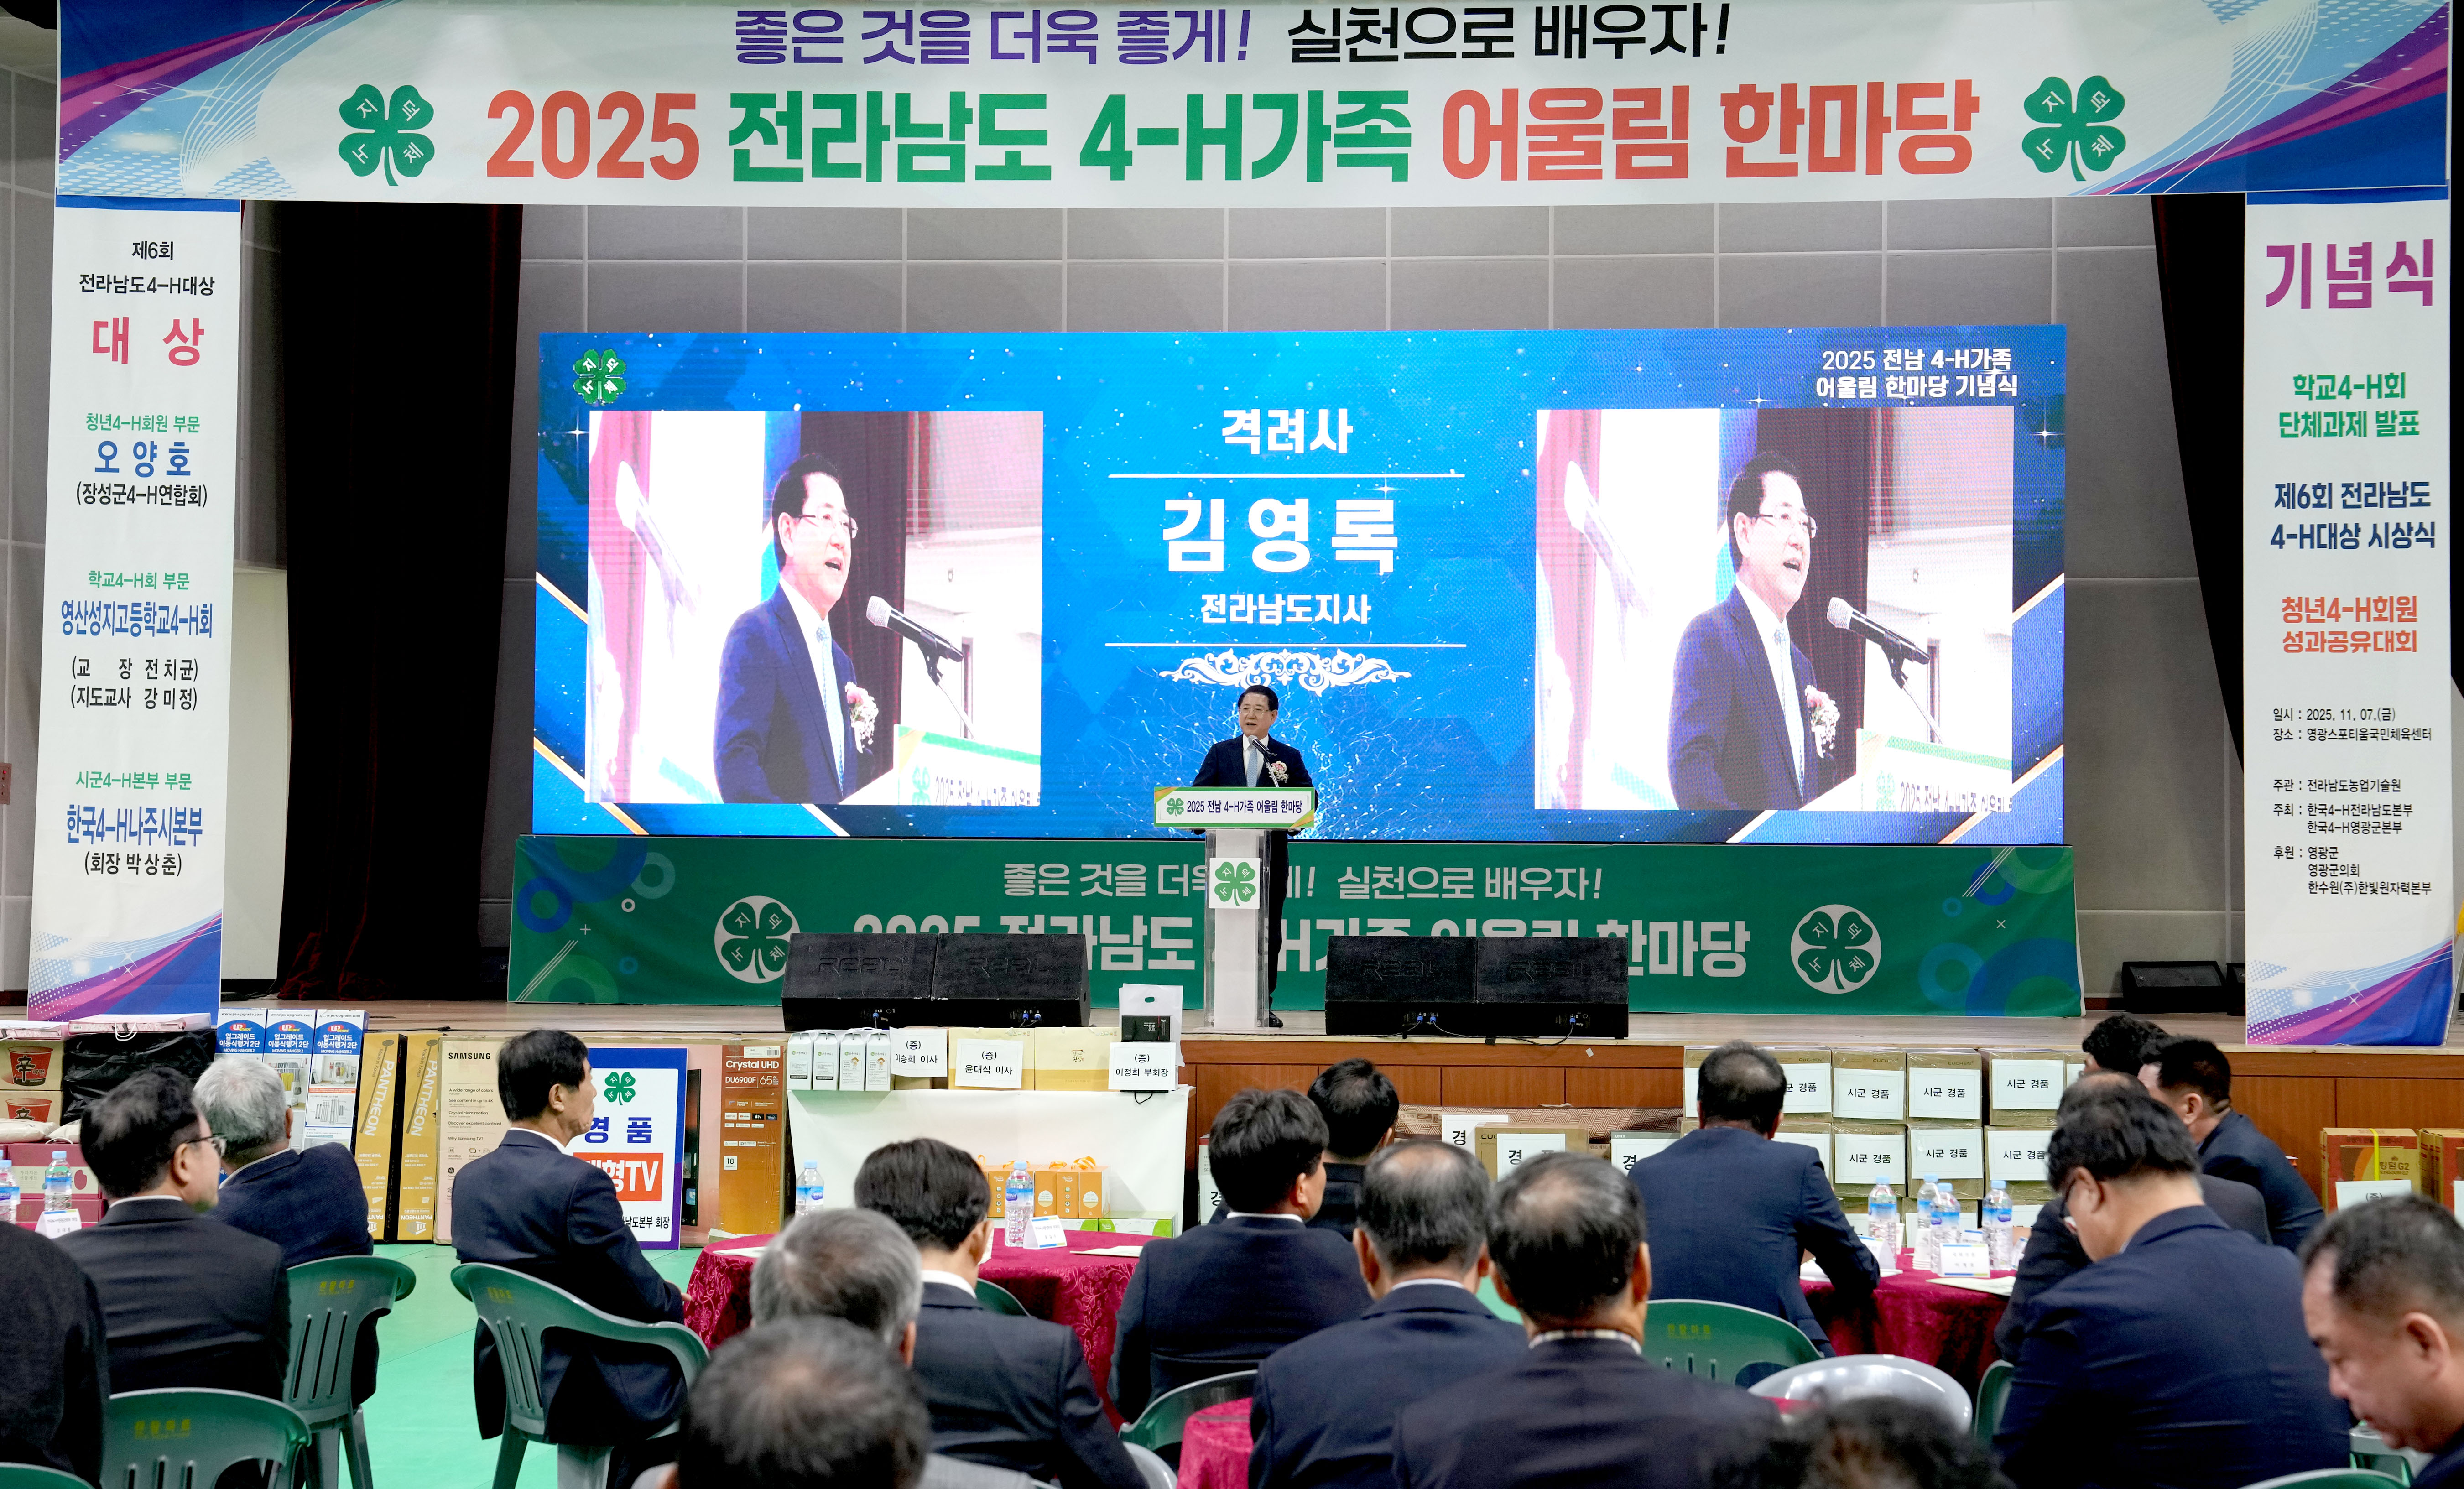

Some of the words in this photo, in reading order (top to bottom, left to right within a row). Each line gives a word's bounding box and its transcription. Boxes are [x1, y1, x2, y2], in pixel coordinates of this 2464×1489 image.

[736, 10, 844, 64] 좋은
[861, 10, 970, 64] 것을
[991, 10, 1098, 64] 더욱
[1118, 9, 1250, 64] 좋게!
[1288, 7, 1514, 63] 실천으로
[1534, 2, 1731, 60] 배우자!
[356, 98, 378, 118] 지
[487, 90, 699, 180] 2025
[729, 91, 1051, 182] 전라남도
[1080, 90, 1412, 182] 4-H가족
[1443, 85, 1689, 181] 어울림
[1720, 79, 1980, 178] 한마당
[352, 144, 368, 164] 노
[403, 142, 424, 163] 체
[132, 241, 173, 260] 제6회
[2266, 239, 2433, 309] 기념식
[79, 274, 214, 296] 전라남도4-H대상
[1823, 351, 1875, 370] 2025
[1883, 349, 1925, 370] 전남
[1931, 348, 2011, 373] 4-H가족
[1817, 376, 1876, 398] 어울림
[1885, 375, 1949, 399] 한마당
[1956, 371, 2017, 397] 기념식
[2293, 372, 2406, 401] 학교4-H회
[86, 413, 167, 432] 청년4-H회원
[173, 416, 200, 433] 부문
[1222, 409, 1353, 454] 격려사
[2280, 411, 2367, 438] 단체과제
[2376, 410, 2420, 437] 발표
[77, 481, 207, 508] (장성군4-H연합회)
[2275, 483, 2332, 509] 제6회
[2341, 481, 2431, 509] 전라남도
[2271, 523, 2361, 549] 4-H대상
[2369, 522, 2435, 549] 시상식
[89, 571, 157, 589] 학교4-H회
[163, 573, 189, 590] 부문
[62, 600, 212, 638] 영산성지고등학교4-H회
[1201, 594, 1371, 626] 전라남도지사
[2282, 596, 2417, 623] 청년4-H회원
[2283, 630, 2417, 653] 성과공유대회
[73, 656, 90, 679] (교
[119, 658, 132, 679] 장
[71, 685, 131, 708] (지도교사
[2274, 708, 2292, 721] 일시
[2307, 709, 2334, 721] 2025.
[2341, 709, 2355, 721] 11.
[2360, 708, 2395, 721] 07.(금)
[2273, 728, 2293, 741] 장소
[2308, 728, 2431, 741] 영광스포티움국민체육센터
[76, 771, 159, 790] 시군4-H본부
[165, 773, 192, 790] 부문
[2273, 779, 2293, 792] 주관
[2308, 779, 2400, 792] 전라남도농업기술원
[1187, 801, 1204, 812] 2025
[1208, 800, 1221, 813] 전남
[1224, 800, 1254, 813] 4-H가족
[1257, 800, 1277, 813] 어울림
[1281, 800, 1302, 813] 한마당
[2273, 804, 2293, 816] 주최
[2308, 803, 2412, 817] 한국4-H전라남도본부
[67, 805, 203, 847] 한국4-H나주시본부
[2308, 821, 2402, 834] 한국4-H영광군본부
[2274, 846, 2293, 859] 후원
[2308, 847, 2339, 859] 영광군
[85, 851, 120, 875] (회장
[2308, 864, 2359, 877] 영광군의회
[1004, 864, 1069, 896] 좋은
[1080, 864, 1146, 896] 것을
[1338, 866, 1474, 899] 실천으로
[1485, 867, 1602, 900] 배우자!
[2308, 881, 2432, 895] 한수원(주)한빛원자력본부
[218, 1039, 249, 1049] 이동식행거
[268, 1040, 297, 1048] 이동식행거
[318, 1040, 346, 1048] 이동식행거
[906, 1041, 921, 1050] (증)
[896, 1054, 915, 1063] 이승희
[921, 1055, 937, 1063] 이사
[982, 1051, 996, 1060] (증)
[1135, 1054, 1149, 1063] (증)
[16, 1055, 36, 1082] 辛
[726, 1061, 759, 1070] Crystal
[965, 1065, 990, 1074] 윤대식
[996, 1066, 1012, 1074] 이사
[1799, 1083, 1816, 1092] 경품
[1924, 1088, 1942, 1097] 시군
[1948, 1088, 1965, 1098] 경품
[2007, 1079, 2025, 1088] 시군
[2032, 1080, 2048, 1088] 경품
[364, 1060, 395, 1137] PANTHEON
[411, 1060, 438, 1136] PANTHEON
[1848, 1089, 1866, 1097] 시군
[1872, 1090, 1889, 1099] 경품
[627, 1117, 652, 1143] 품
[1850, 1154, 1867, 1162] 시군
[1874, 1155, 1891, 1163] 경품
[1926, 1149, 1944, 1158] 시군
[1950, 1149, 1967, 1158] 경품
[2004, 1151, 2021, 1159] 시군
[2027, 1151, 2046, 1160] 경품
[656, 1217, 670, 1229] 회장
